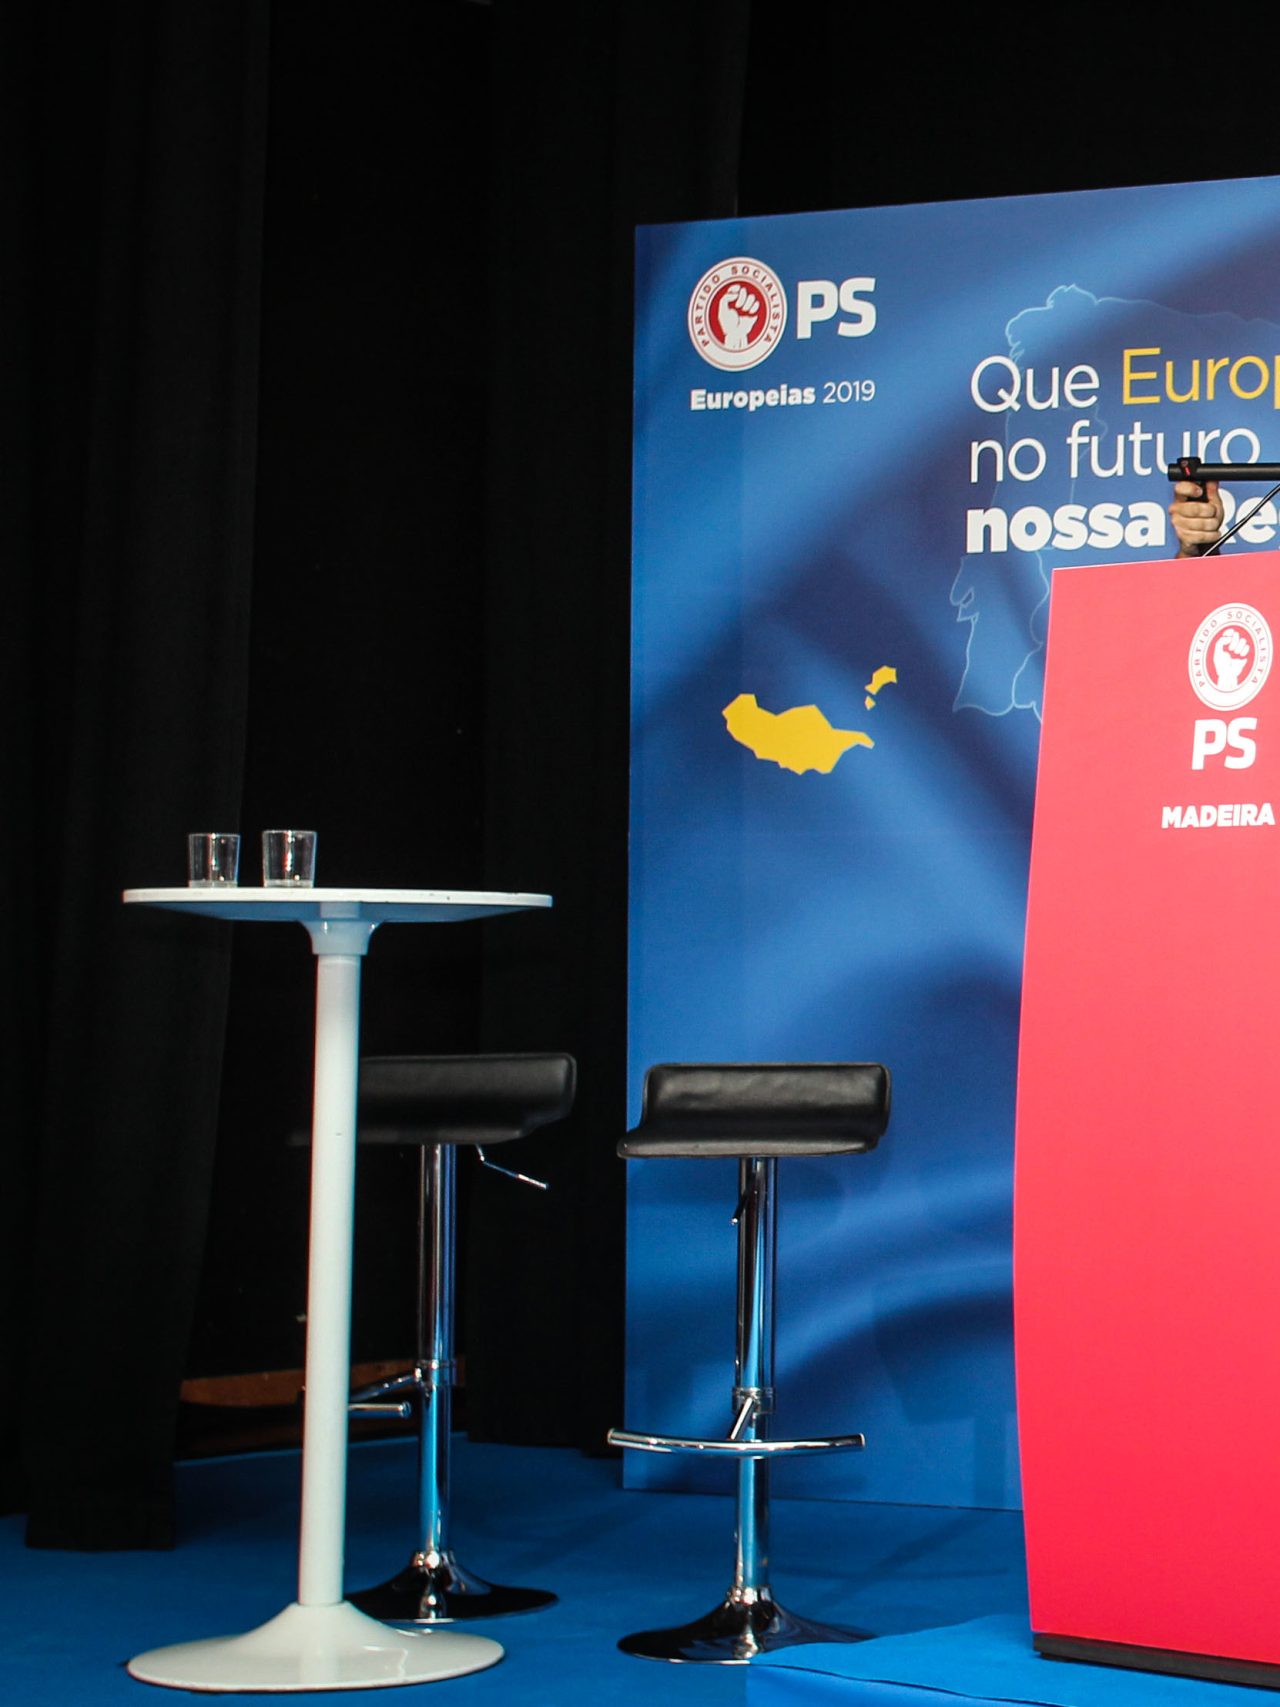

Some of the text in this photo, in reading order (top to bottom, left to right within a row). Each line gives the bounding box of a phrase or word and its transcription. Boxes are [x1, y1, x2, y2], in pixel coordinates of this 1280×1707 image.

[695, 265, 782, 348] PARTIDO SOCIALISTA
[796, 277, 877, 340] PS
[690, 380, 876, 412] Europeias 2019
[970, 355, 1101, 413] Que
[970, 437, 1047, 484] no
[1066, 419, 1261, 479] futuro
[966, 501, 1166, 553] nossa
[1193, 611, 1267, 688] PARTIDO SOCIALISTA
[1191, 716, 1258, 771] PS
[1161, 802, 1276, 829] MADEIRA
